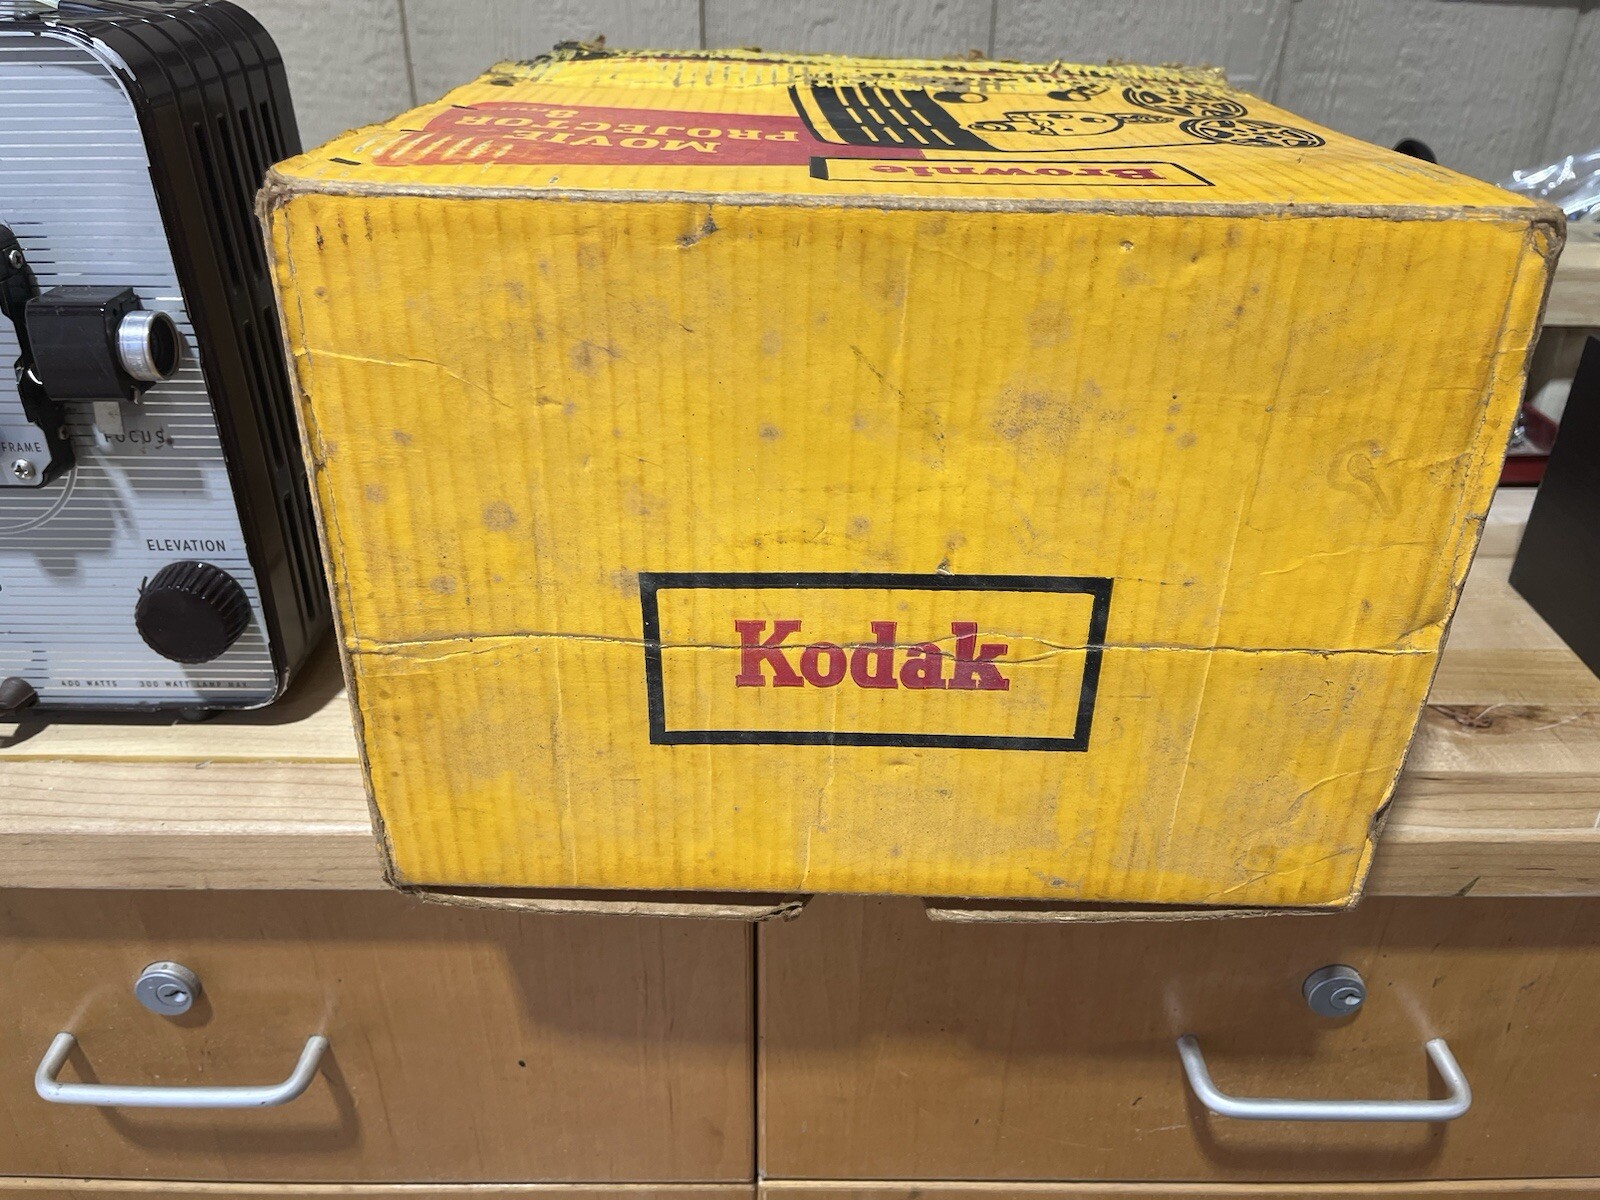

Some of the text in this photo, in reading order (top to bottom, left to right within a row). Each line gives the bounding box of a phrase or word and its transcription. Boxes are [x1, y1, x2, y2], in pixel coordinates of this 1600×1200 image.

[454, 116, 800, 143] PROJECTOR
[502, 130, 721, 154] MOVIE
[868, 165, 1168, 180] Brownie
[1, 442, 42, 453] FRAME
[147, 539, 226, 552] ELEVATION
[734, 619, 1010, 691] Kodak
[87, 680, 118, 688] WATTS
[140, 680, 248, 688] 300 WATT LAMP MAX
